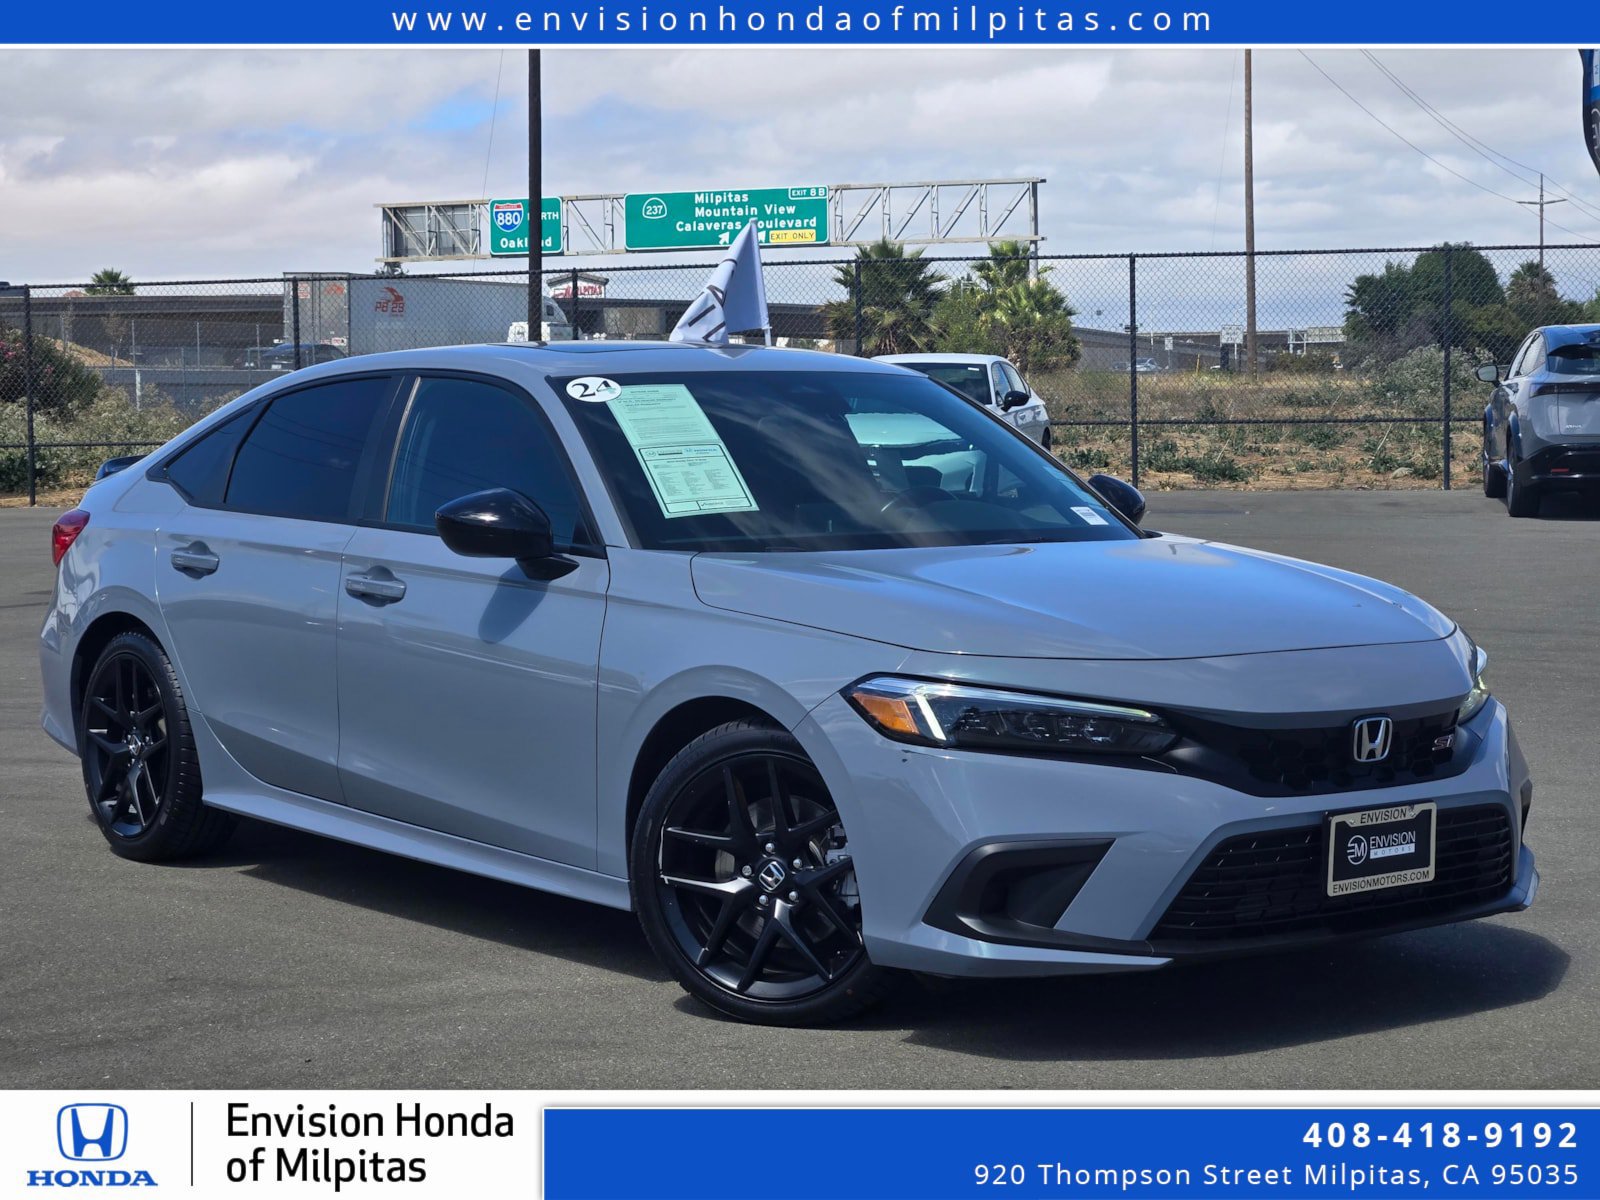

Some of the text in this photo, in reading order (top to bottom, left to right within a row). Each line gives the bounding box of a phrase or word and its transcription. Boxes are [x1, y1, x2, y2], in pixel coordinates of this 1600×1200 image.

[695, 193, 749, 205] Milpitas
[791, 189, 807, 197] EXIT
[528, 211, 560, 221] RTH
[646, 205, 663, 216] 237
[695, 204, 796, 218] Mountain View
[497, 212, 520, 226] 880
[676, 216, 817, 232] Calaveras oulevard
[500, 236, 552, 249] Oakld
[770, 231, 815, 241] EXIT ONLY
[571, 380, 614, 398] 24
[1360, 807, 1407, 824] ENVISION
[1370, 830, 1416, 849] ENVISION
[1373, 845, 1412, 856] MOTORS
[1333, 870, 1430, 894] ENVISIONMOTORS.COM
